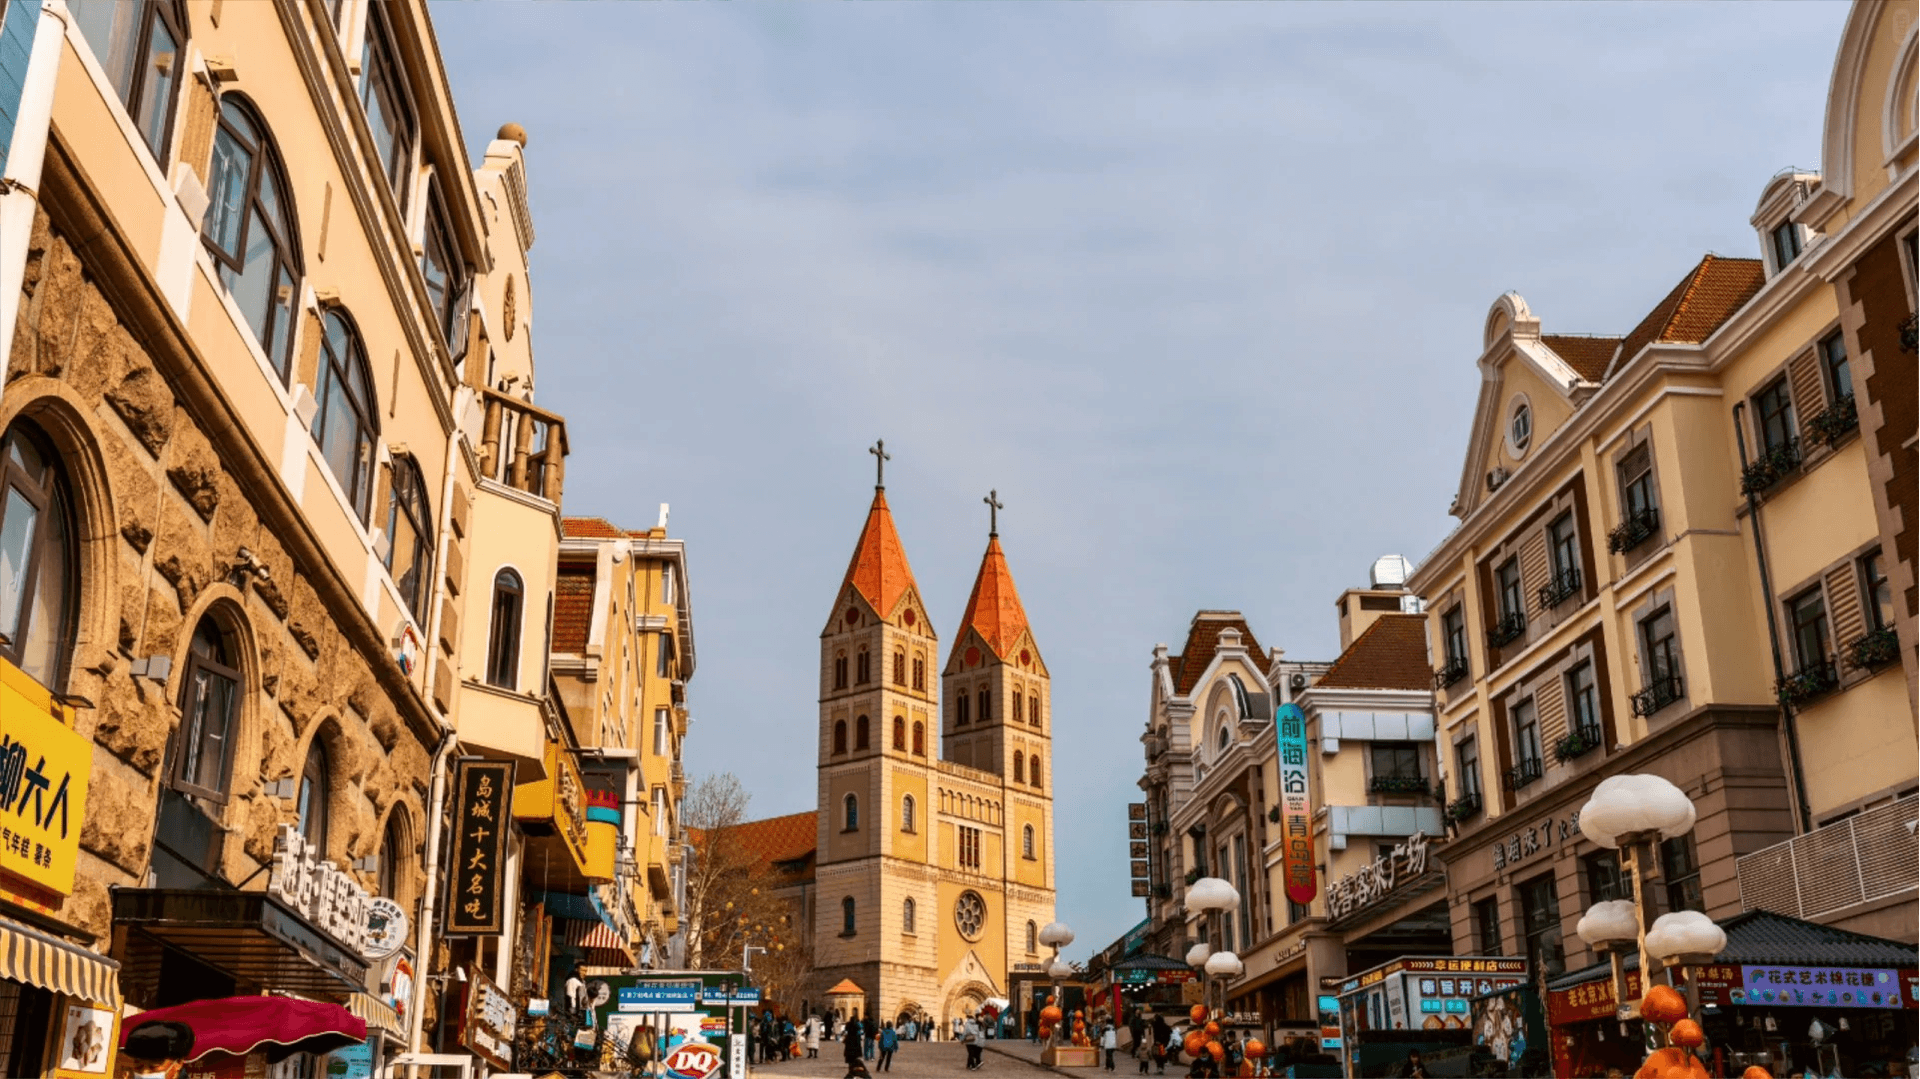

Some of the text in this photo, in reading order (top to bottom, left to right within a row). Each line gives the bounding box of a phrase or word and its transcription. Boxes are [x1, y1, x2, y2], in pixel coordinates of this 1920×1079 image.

[1281, 715, 1305, 794] 前海沿
[0, 826, 31, 859] 气年糕
[464, 774, 493, 920] 岛城十大名吃
[1287, 814, 1312, 886] 青岛菜
[1435, 959, 1498, 972] 幸运便利店
[1768, 969, 1875, 987] 花式艺术棉花糖
[675, 1051, 713, 1073] DQ
